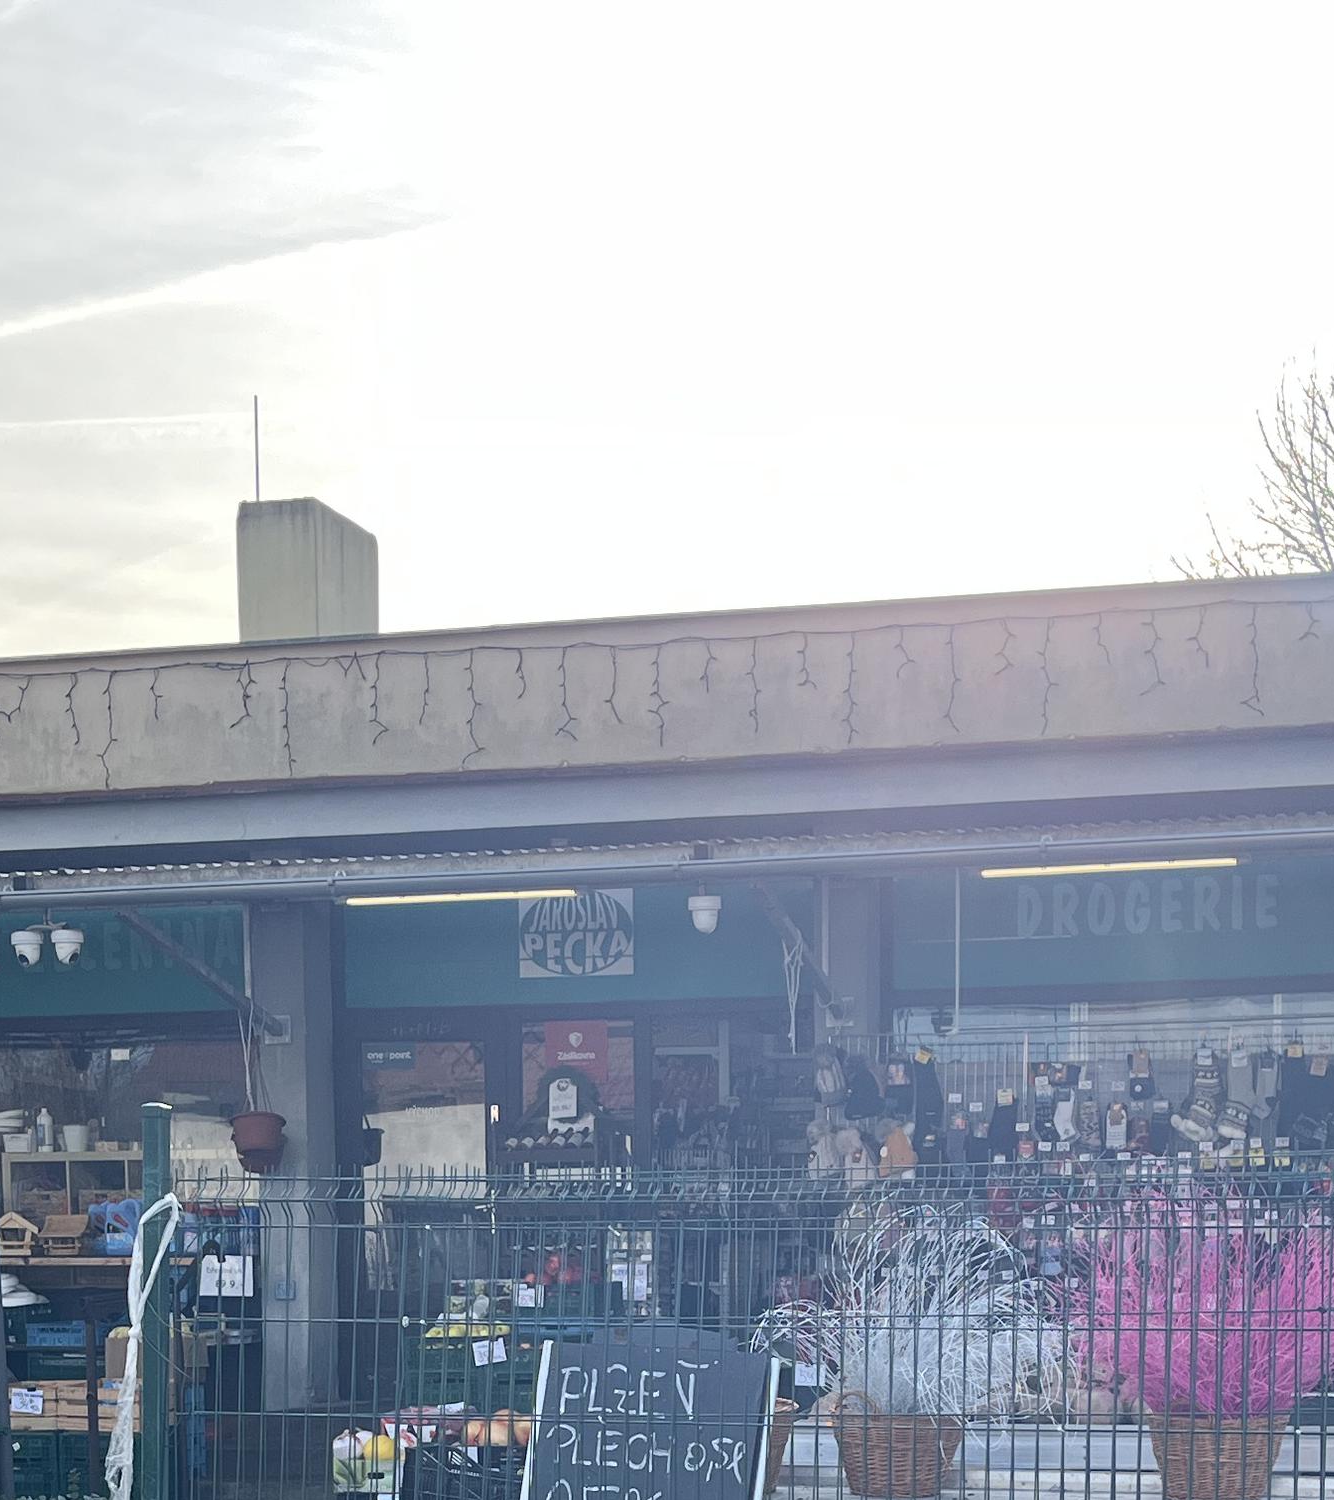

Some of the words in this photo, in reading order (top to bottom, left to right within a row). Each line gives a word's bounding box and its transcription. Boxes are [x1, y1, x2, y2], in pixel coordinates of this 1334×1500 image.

[529, 888, 619, 933] JAROSLAV
[1017, 873, 1280, 938] DROGERIE
[524, 930, 629, 976] PECKA
[547, 1423, 674, 1473] PLECH
